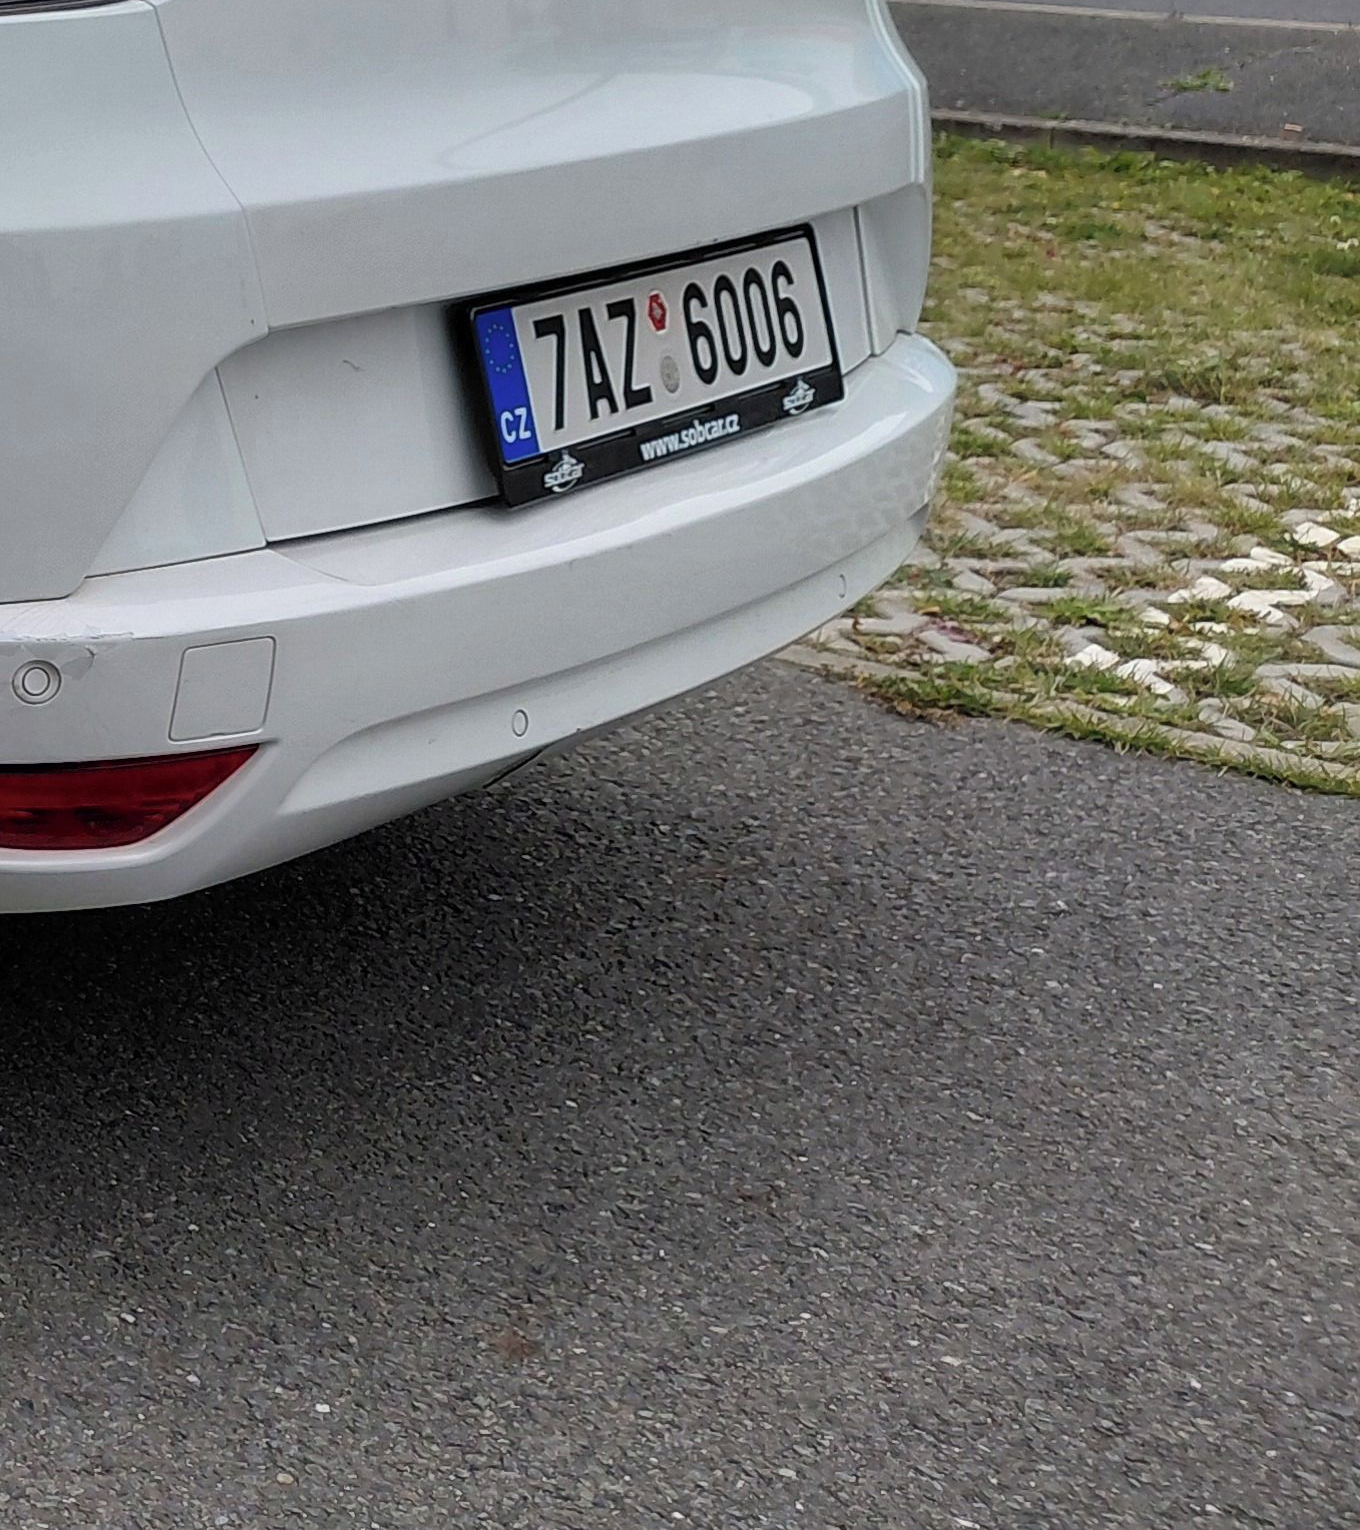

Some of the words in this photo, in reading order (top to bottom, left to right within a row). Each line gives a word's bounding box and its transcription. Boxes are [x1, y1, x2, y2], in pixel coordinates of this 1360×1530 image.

[532, 297, 653, 431] 7AZ
[682, 259, 806, 386] 6006
[500, 405, 533, 445] CZ
[639, 413, 742, 462] www.sobcar.cz
